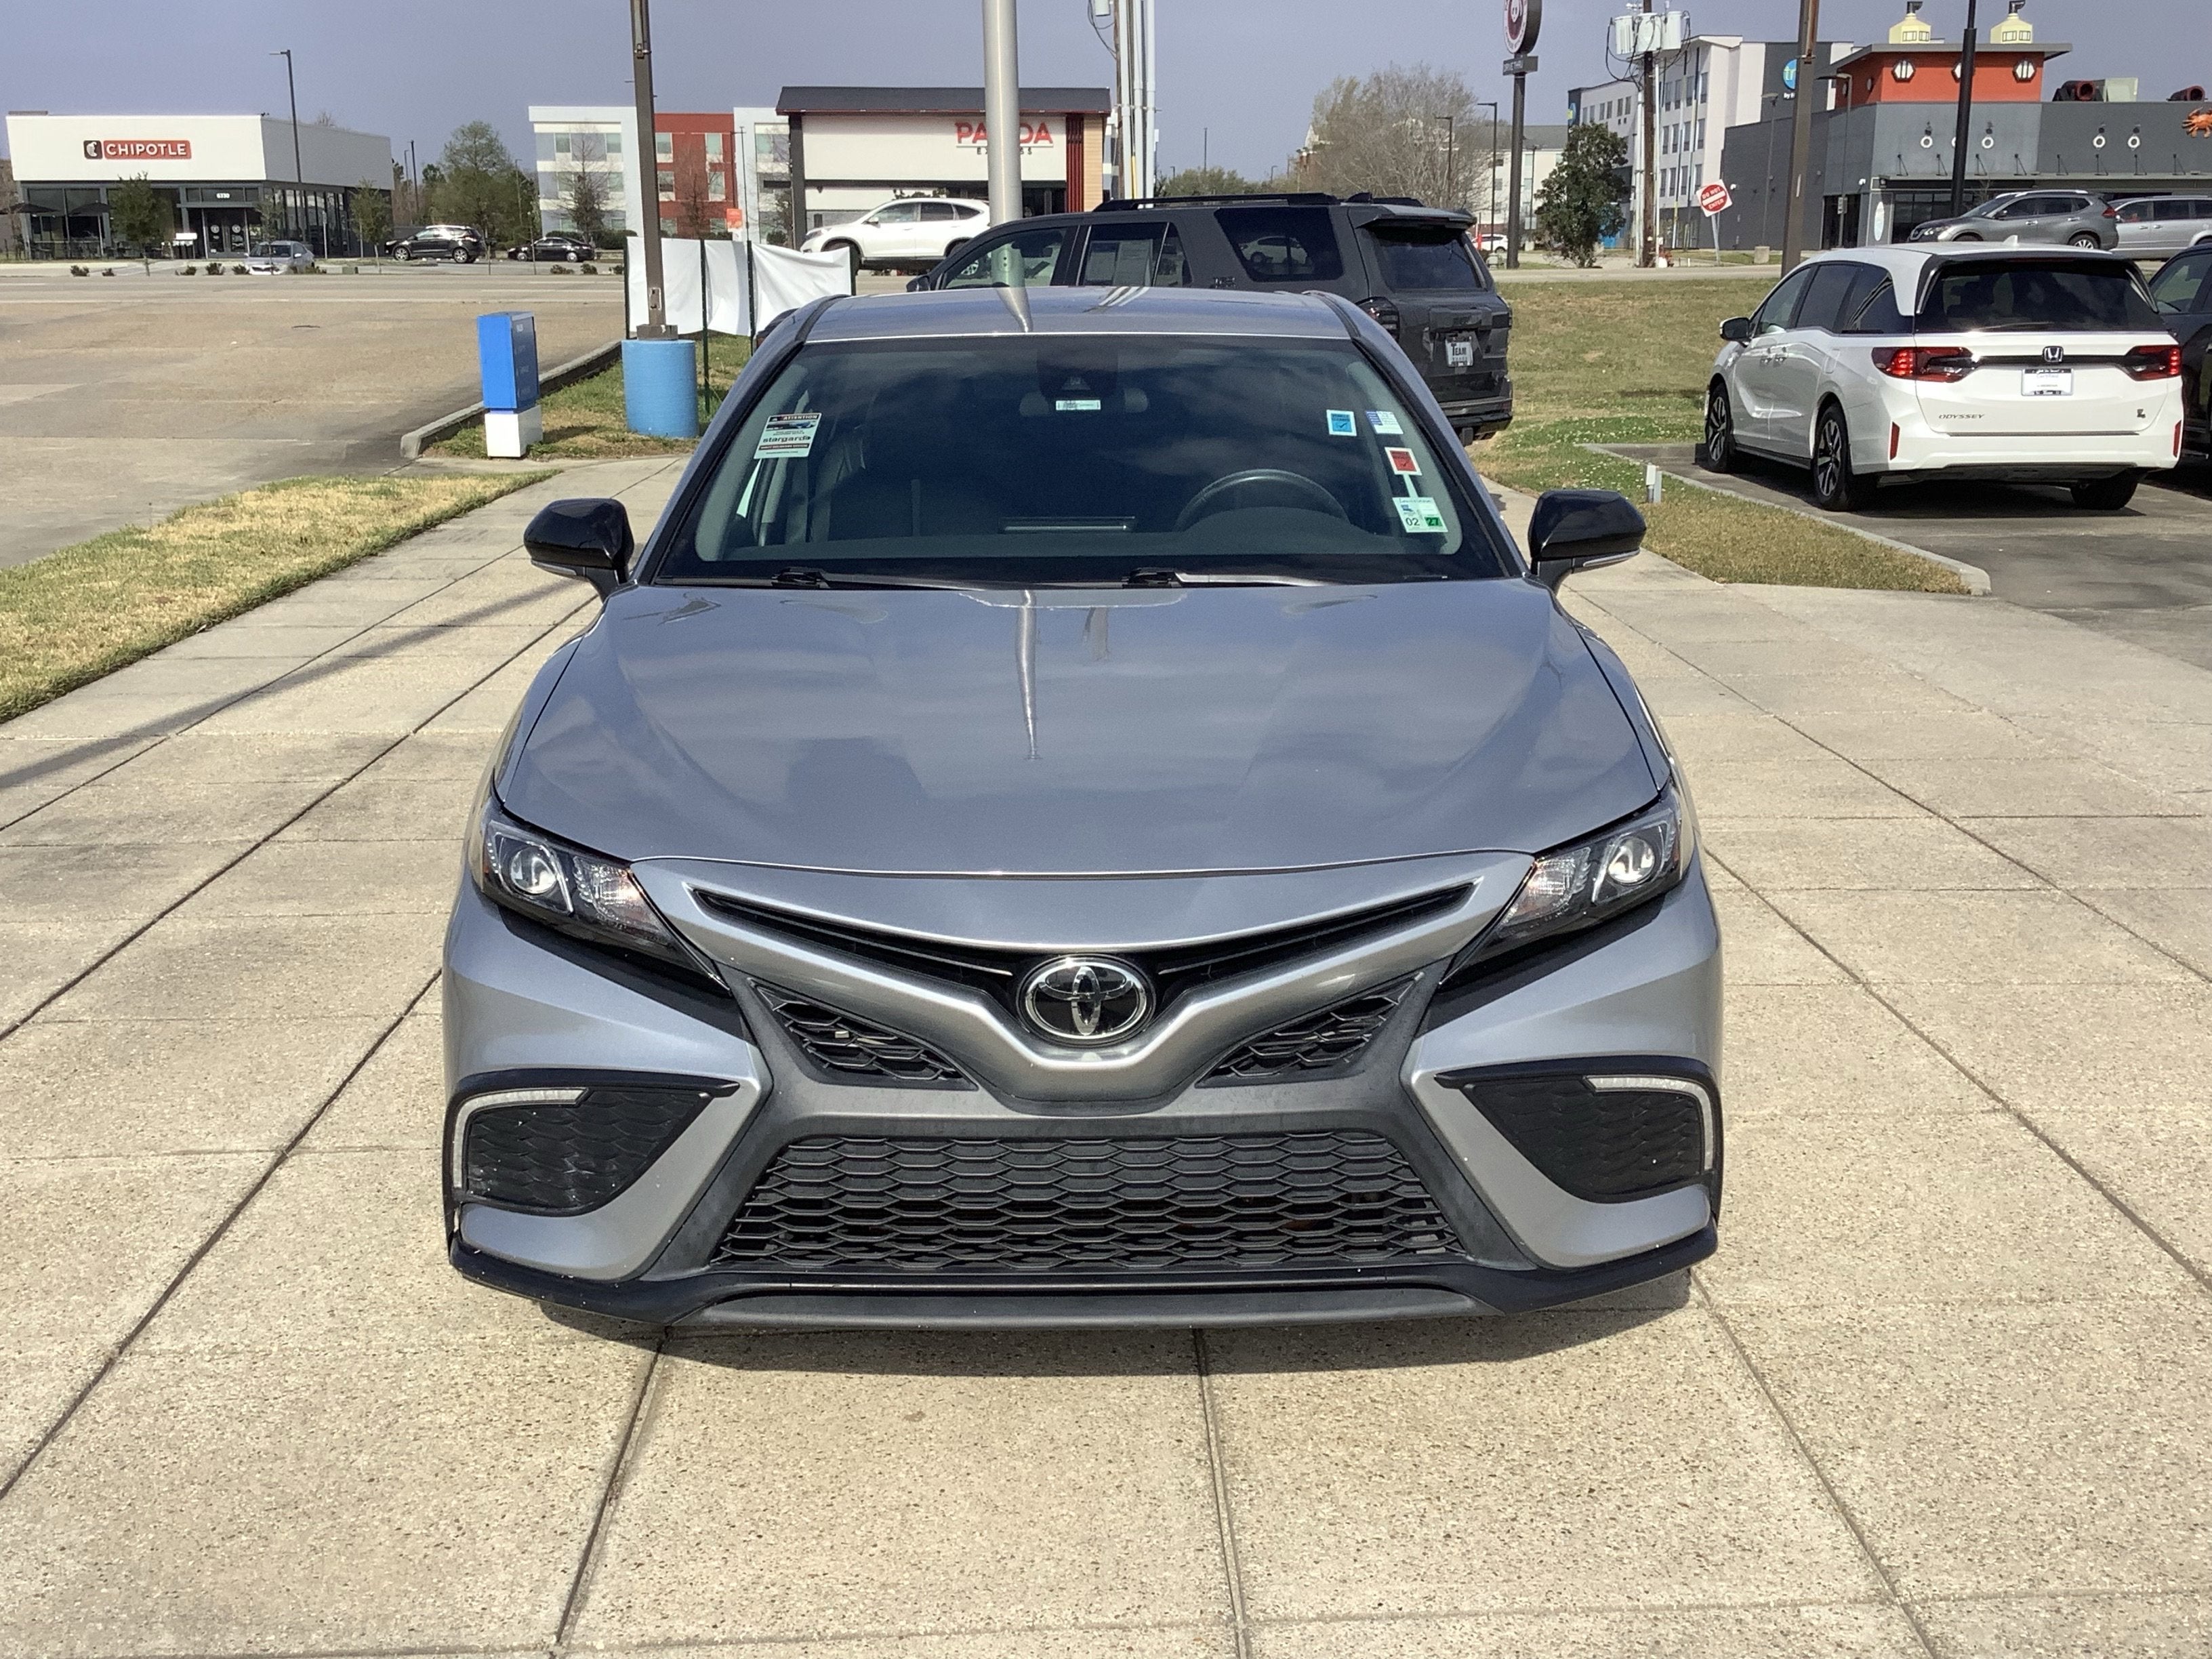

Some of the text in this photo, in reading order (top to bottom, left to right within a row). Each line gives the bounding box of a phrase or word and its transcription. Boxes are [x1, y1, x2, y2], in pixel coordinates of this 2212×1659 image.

[955, 122, 1052, 144] PADA
[106, 144, 186, 156] CHIPOTLE
[1710, 186, 1721, 195] NOT
[1708, 199, 1724, 209] ENTER
[1406, 517, 1439, 527] 02 27
